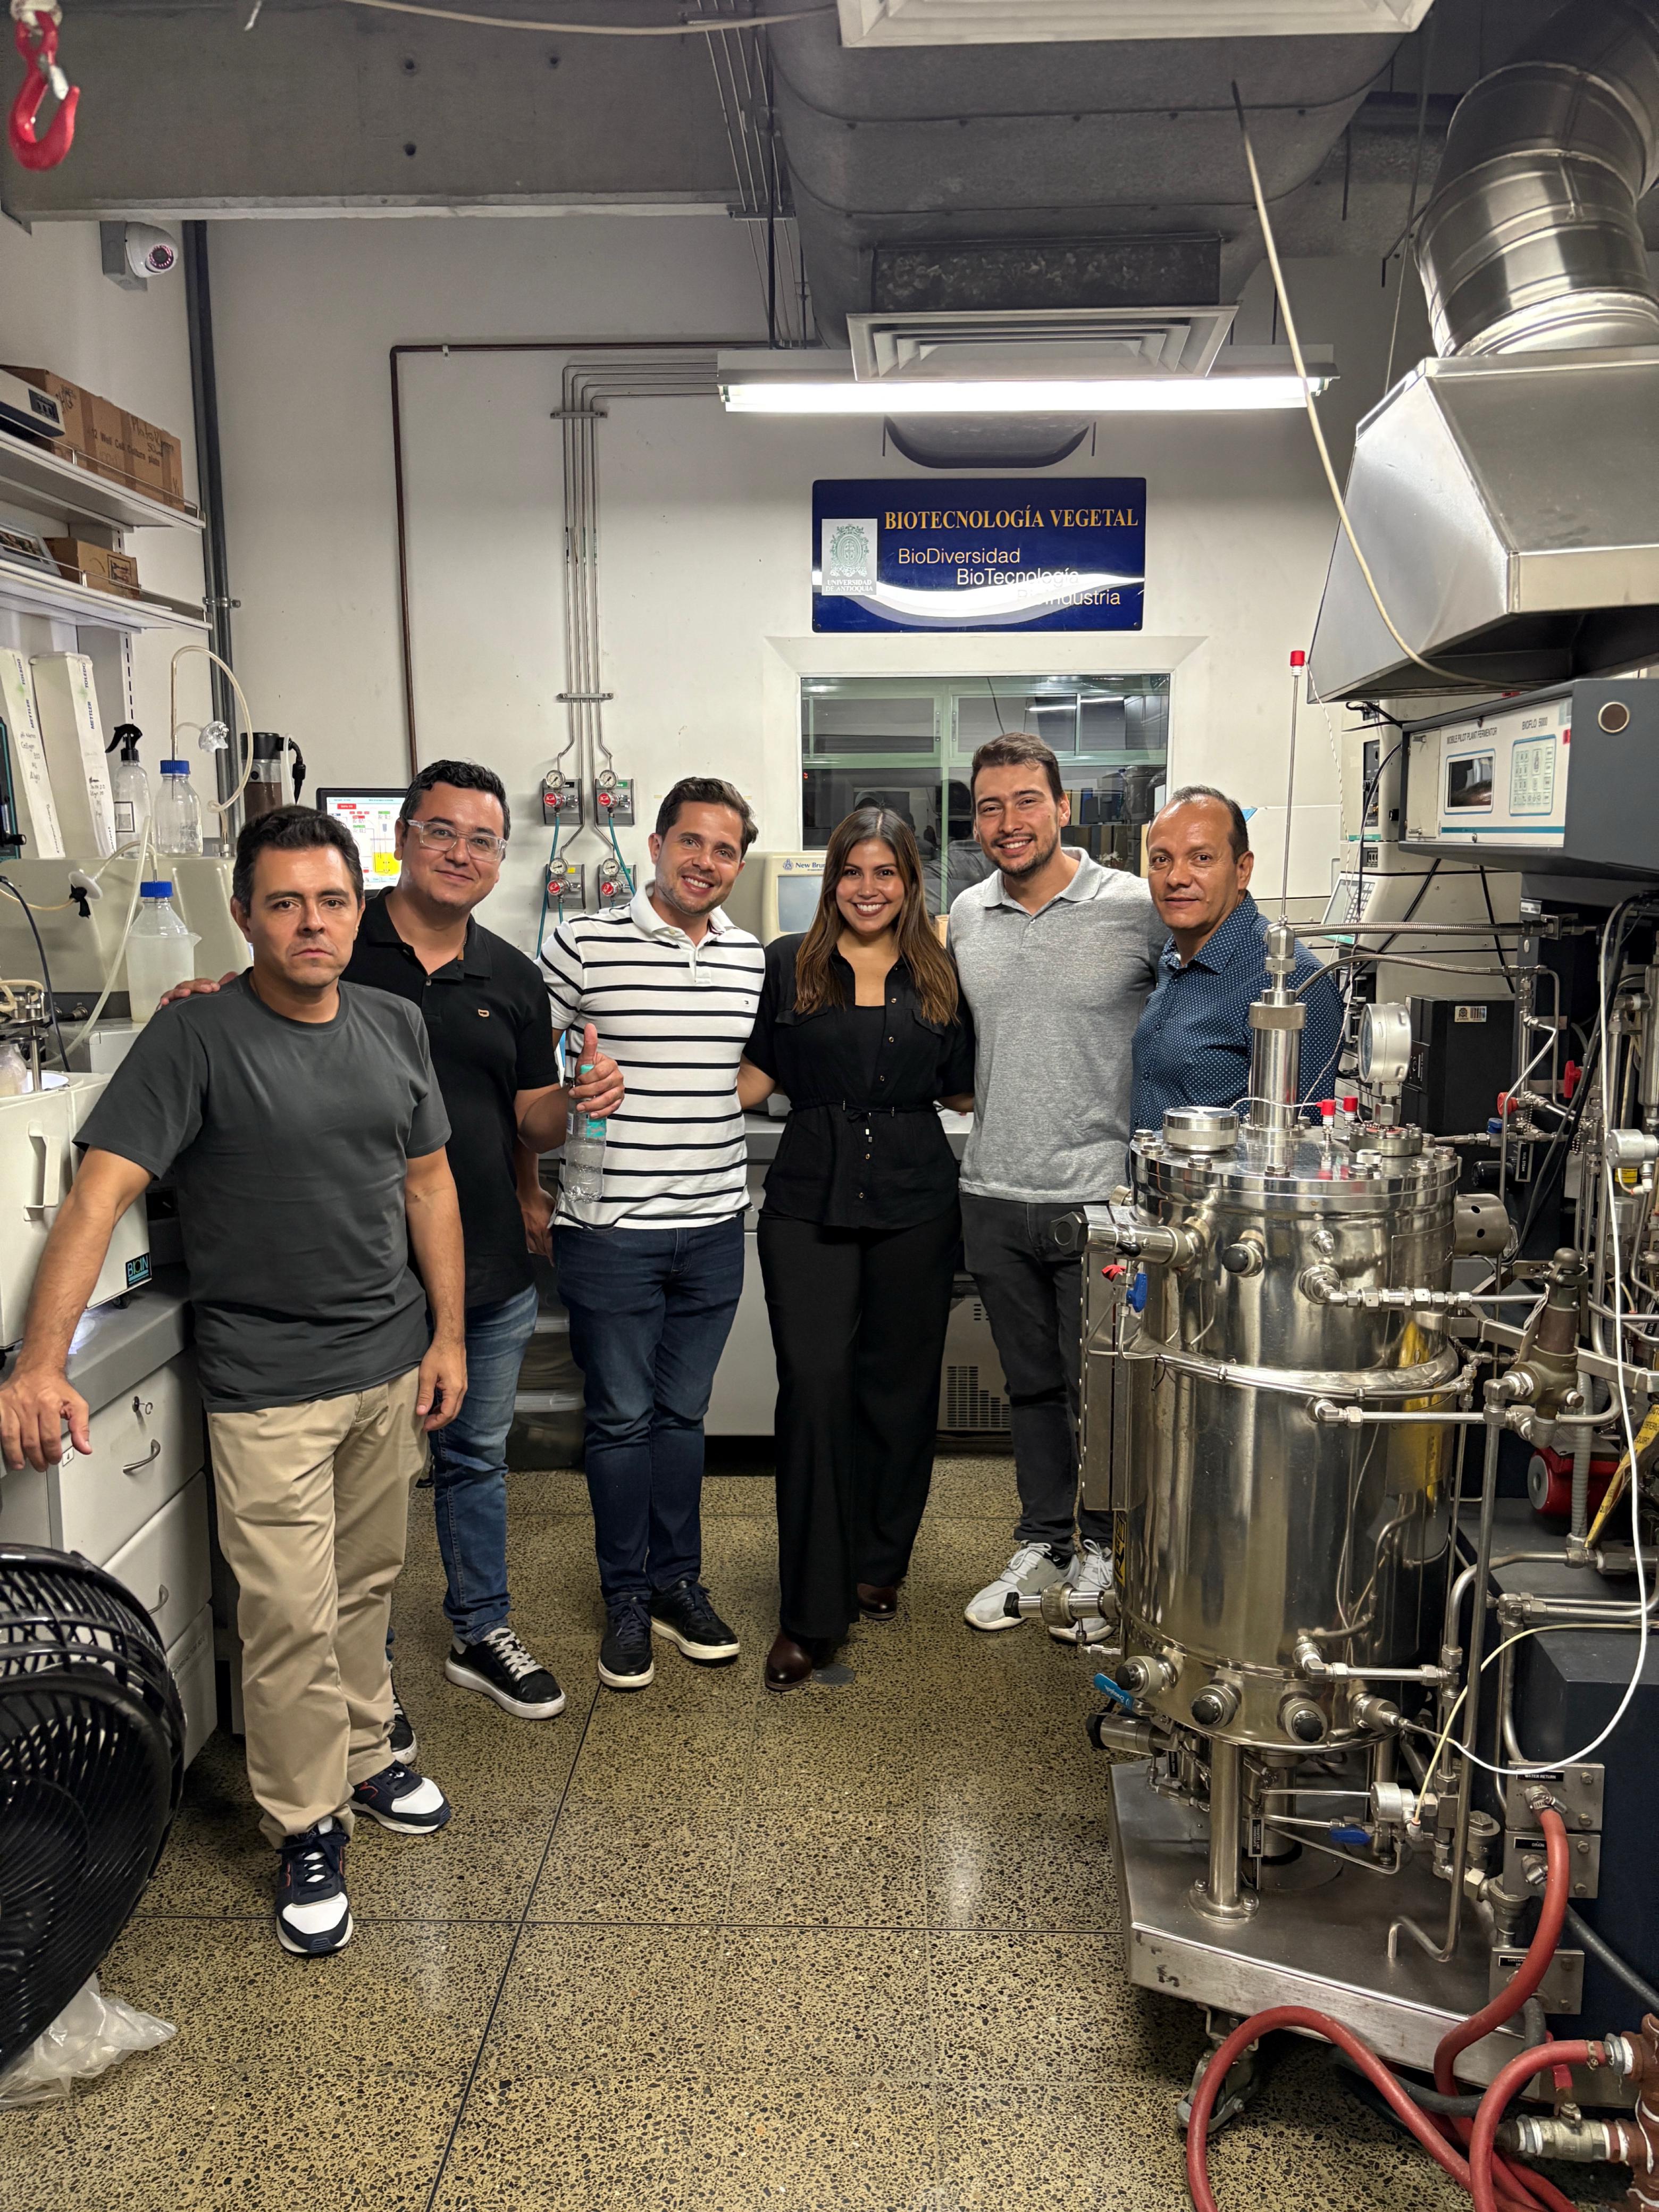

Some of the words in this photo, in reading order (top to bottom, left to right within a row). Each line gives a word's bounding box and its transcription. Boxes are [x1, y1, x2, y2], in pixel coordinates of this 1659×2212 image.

[884, 505, 1045, 530] BIOTECNOLOGÍA
[1049, 508, 1139, 527] VEGETAL
[898, 547, 1020, 564] BioDiversidad
[957, 567, 1079, 588] BioTecnología
[16, 658, 26, 685] TOLEDO
[26, 699, 35, 728] METTLER
[1522, 719, 1537, 731] BIOFLO
[1447, 734, 1457, 744] MOBILE
[1457, 732, 1467, 742] PILOT
[1467, 730, 1477, 741] PLANT
